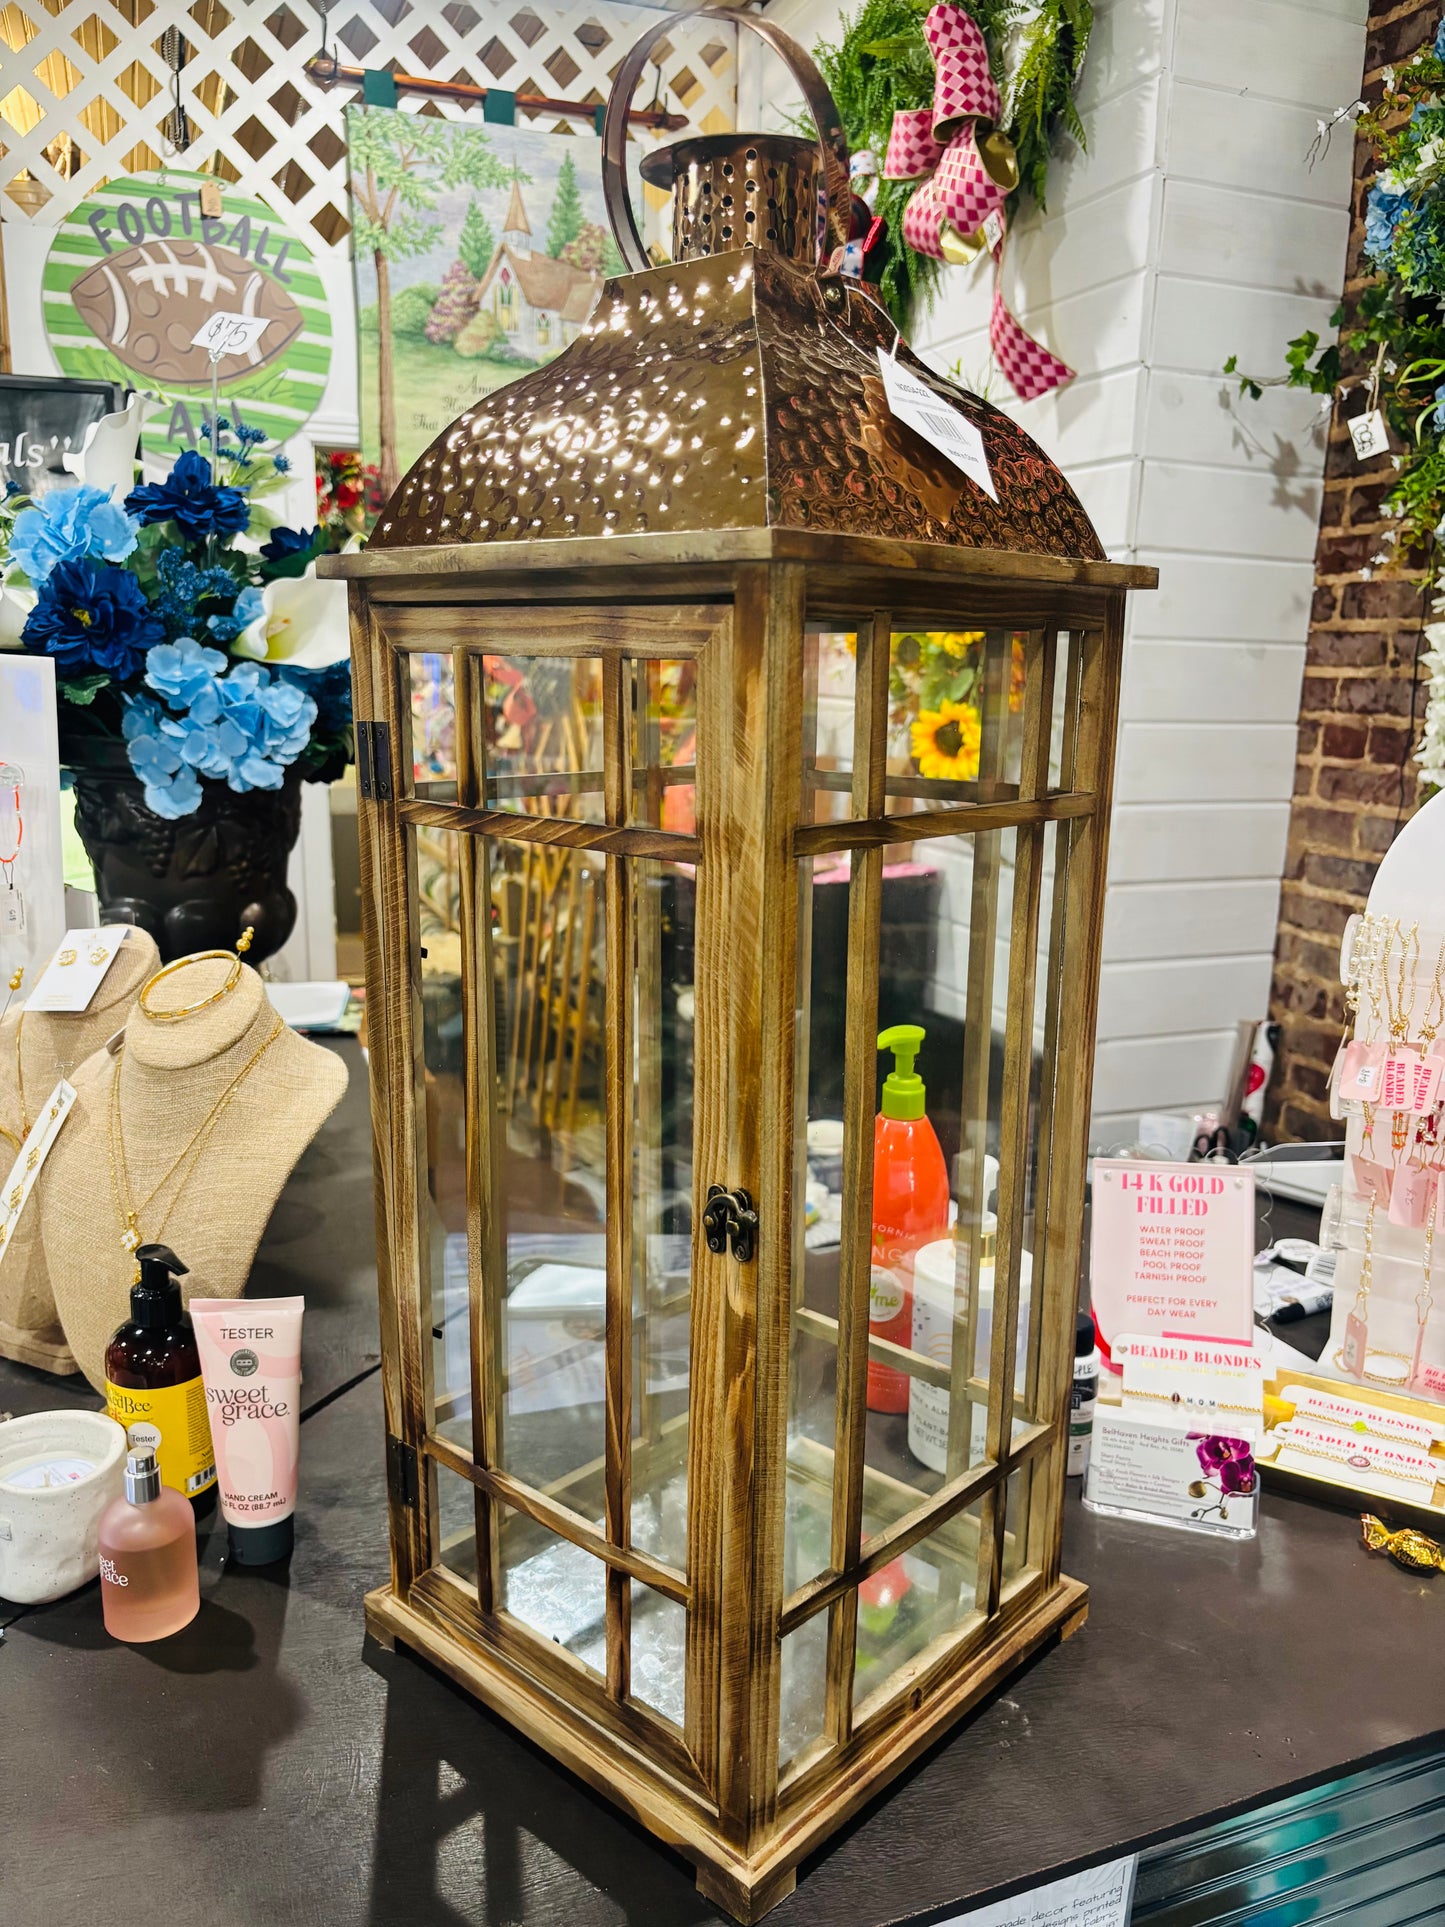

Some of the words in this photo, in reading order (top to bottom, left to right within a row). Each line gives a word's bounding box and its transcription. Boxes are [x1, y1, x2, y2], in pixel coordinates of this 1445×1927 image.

[88, 192, 292, 284] FOOTBALL
[1385, 1061, 1395, 1107] BLONDES
[1395, 1063, 1406, 1105] BEADED
[1414, 1068, 1432, 1110] BEADED
[1121, 1173, 1144, 1190] 14
[1149, 1174, 1163, 1192] K
[1169, 1175, 1225, 1194] GOLD
[1137, 1196, 1208, 1216] FILLED
[1139, 1226, 1171, 1235] WATER
[1175, 1227, 1205, 1236] PROOF
[1139, 1237, 1171, 1246] SWEAT
[1174, 1239, 1205, 1248] PROOF
[1139, 1249, 1171, 1258] BEACH
[1173, 1250, 1204, 1260] PROOF
[1143, 1261, 1167, 1269] POOL
[1170, 1262, 1201, 1271] PROOF
[1134, 1272, 1173, 1282] TARNISH
[1176, 1274, 1207, 1283] PROOF
[1126, 1295, 1165, 1304] PERFECT
[1168, 1297, 1186, 1306] FOR
[1189, 1298, 1218, 1308] EVERY
[1147, 1308, 1166, 1317] DAY
[1170, 1309, 1196, 1319] WEAR
[219, 1328, 274, 1340] TESTER
[1130, 1344, 1188, 1361] BEADED
[1194, 1351, 1262, 1369] BLONDES
[206, 1385, 270, 1404] sweet
[1308, 1398, 1364, 1417] BEADED
[1368, 1413, 1433, 1435] BLONDES
[131, 1434, 156, 1443] Tester
[1140, 1433, 1169, 1444] Heights
[1171, 1438, 1190, 1447] Gifts
[1294, 1428, 1357, 1449] BEADED
[1363, 1445, 1437, 1469] BLONDES
[225, 1492, 246, 1502] HAND
[248, 1491, 278, 1502] CREAM
[229, 1502, 236, 1510] FL
[238, 1503, 249, 1511] OZ
[1031, 1905, 1067, 1922] decor
